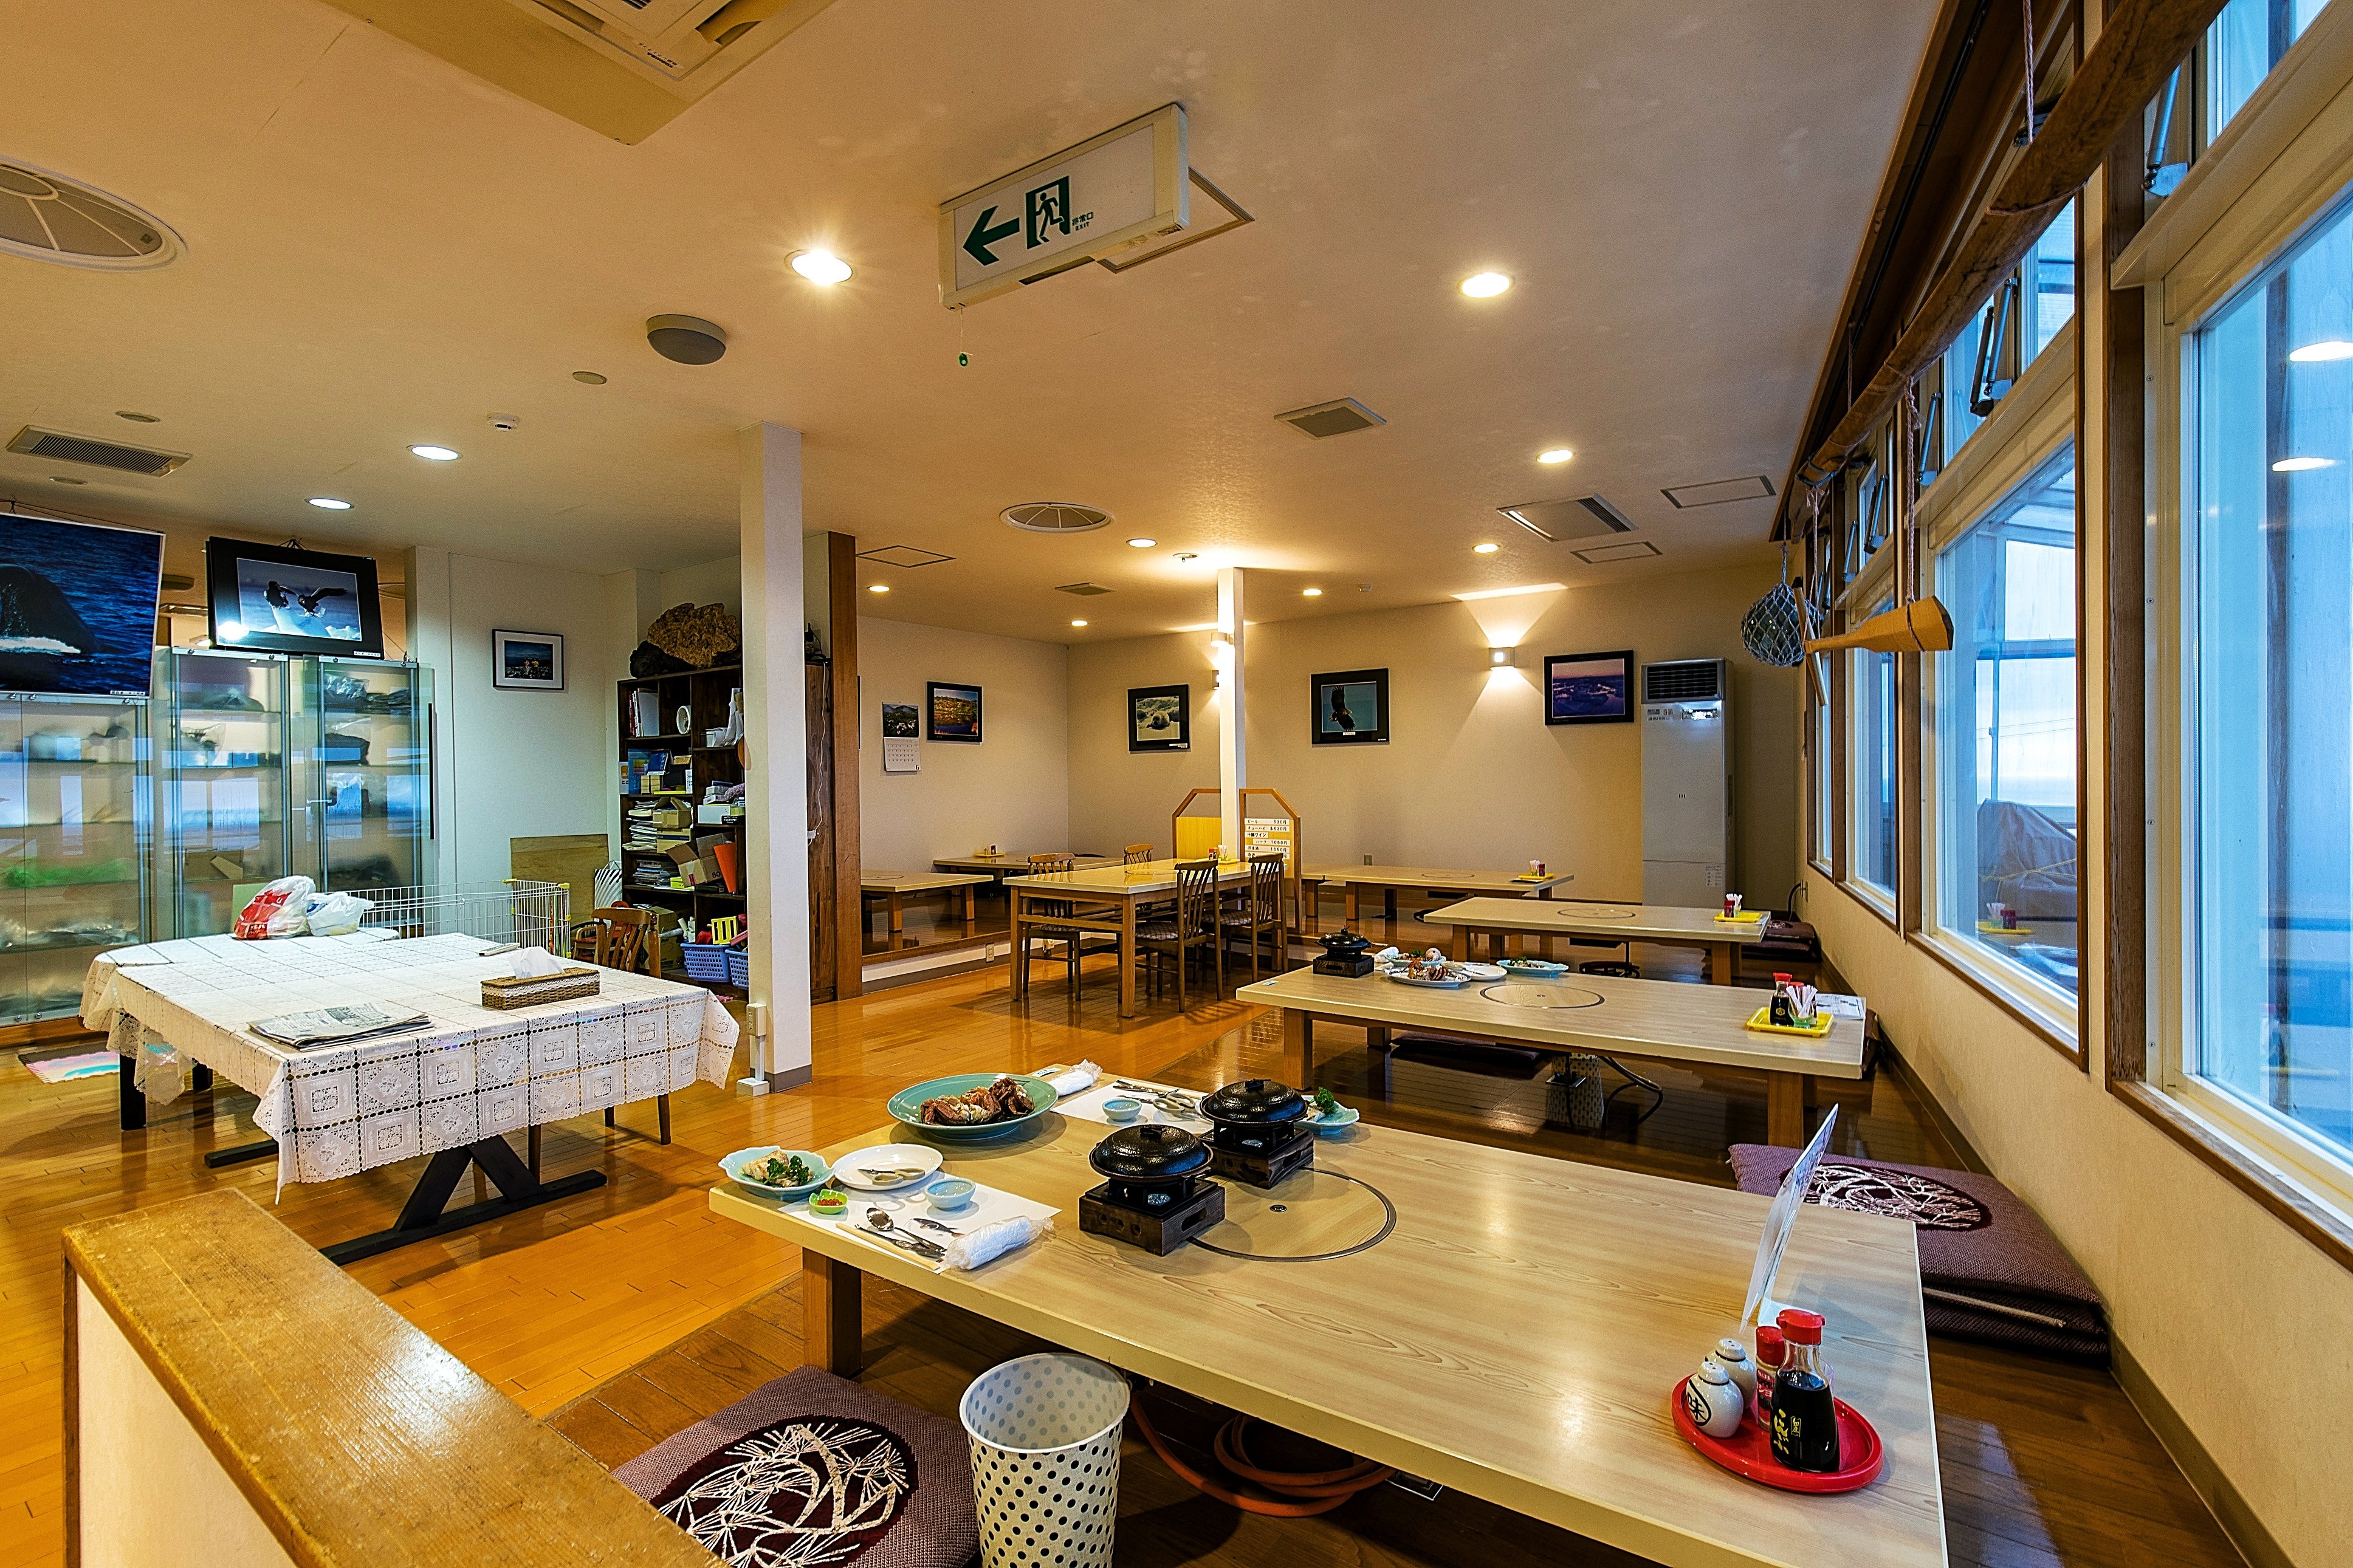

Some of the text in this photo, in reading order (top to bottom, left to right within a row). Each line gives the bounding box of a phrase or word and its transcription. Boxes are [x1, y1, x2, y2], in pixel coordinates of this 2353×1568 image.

[1071, 212, 1093, 226] 非常口
[1076, 221, 1090, 231] EXIT
